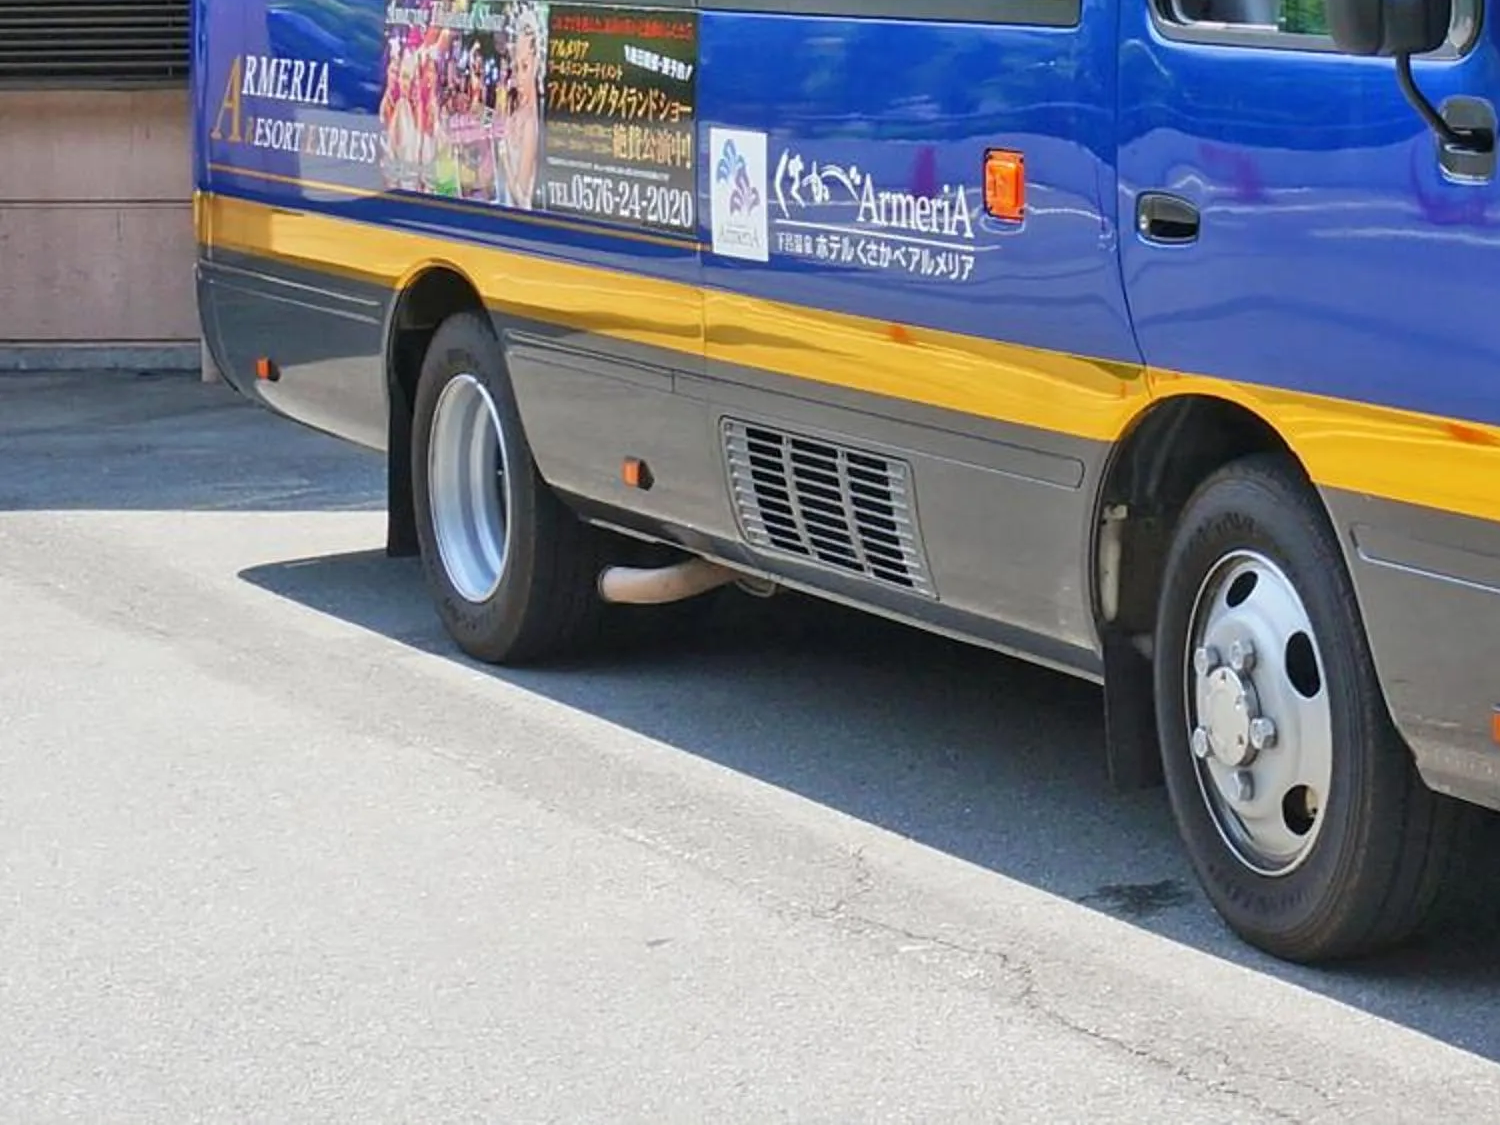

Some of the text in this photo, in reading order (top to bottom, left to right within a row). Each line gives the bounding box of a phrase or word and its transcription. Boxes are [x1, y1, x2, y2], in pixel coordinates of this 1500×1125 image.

[305, 125, 377, 163] EXPRESS
[856, 173, 975, 238] ArmeriA
[815, 235, 976, 280] ホテルくさかべアルメリア
